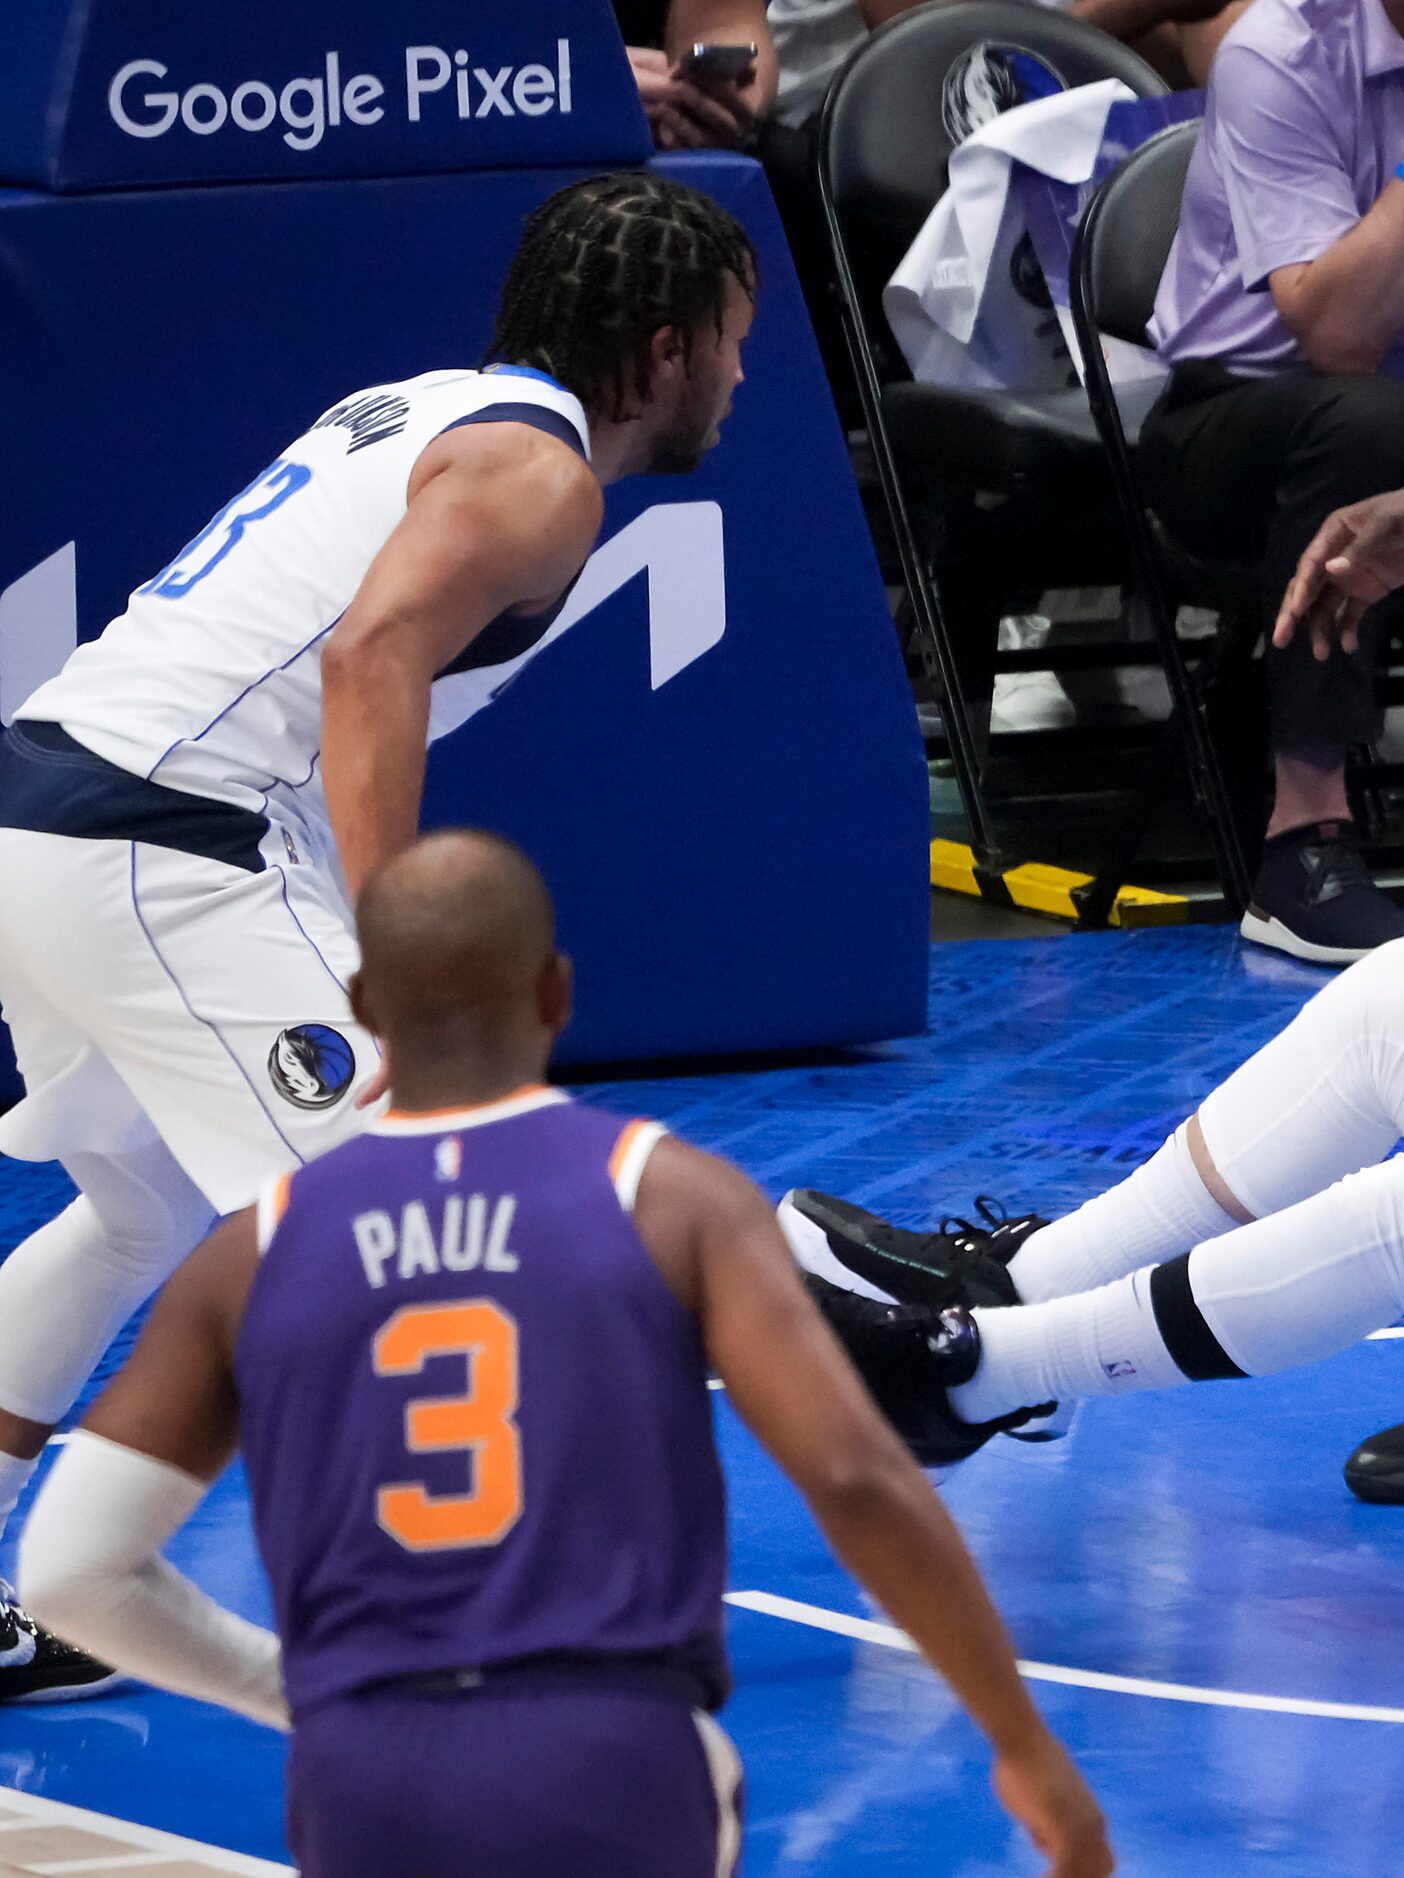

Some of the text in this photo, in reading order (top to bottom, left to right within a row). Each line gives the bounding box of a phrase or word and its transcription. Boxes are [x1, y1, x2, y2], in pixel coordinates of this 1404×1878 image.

[108, 37, 573, 152] Google Pixel
[351, 1192, 521, 1291] PAUL
[371, 1296, 526, 1555] 3
